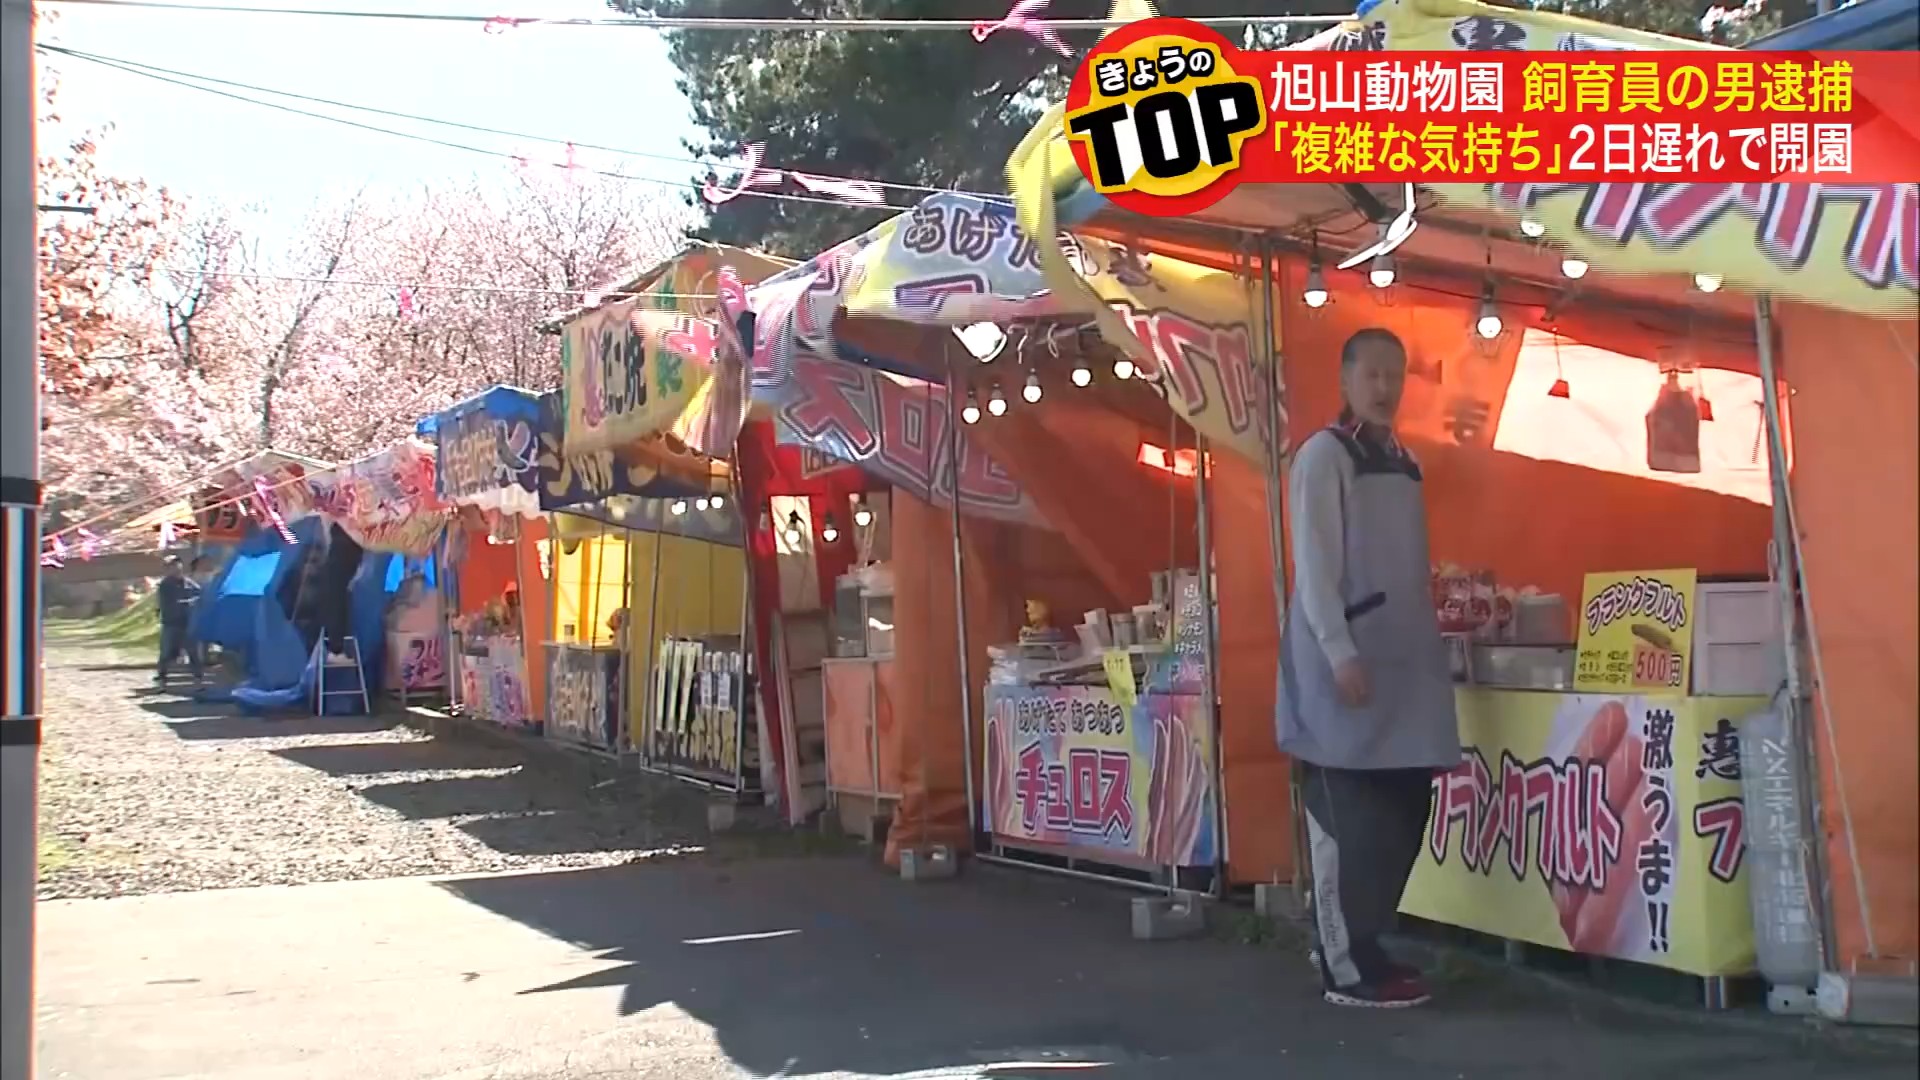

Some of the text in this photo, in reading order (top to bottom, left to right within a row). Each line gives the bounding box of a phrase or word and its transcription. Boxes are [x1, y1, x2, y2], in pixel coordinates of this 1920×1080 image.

[1586, 576, 1687, 636] フランクフルト
[1635, 650, 1684, 687] 500円
[1018, 698, 1125, 737] あげたて あつあつ
[1016, 738, 1134, 845] チュロス
